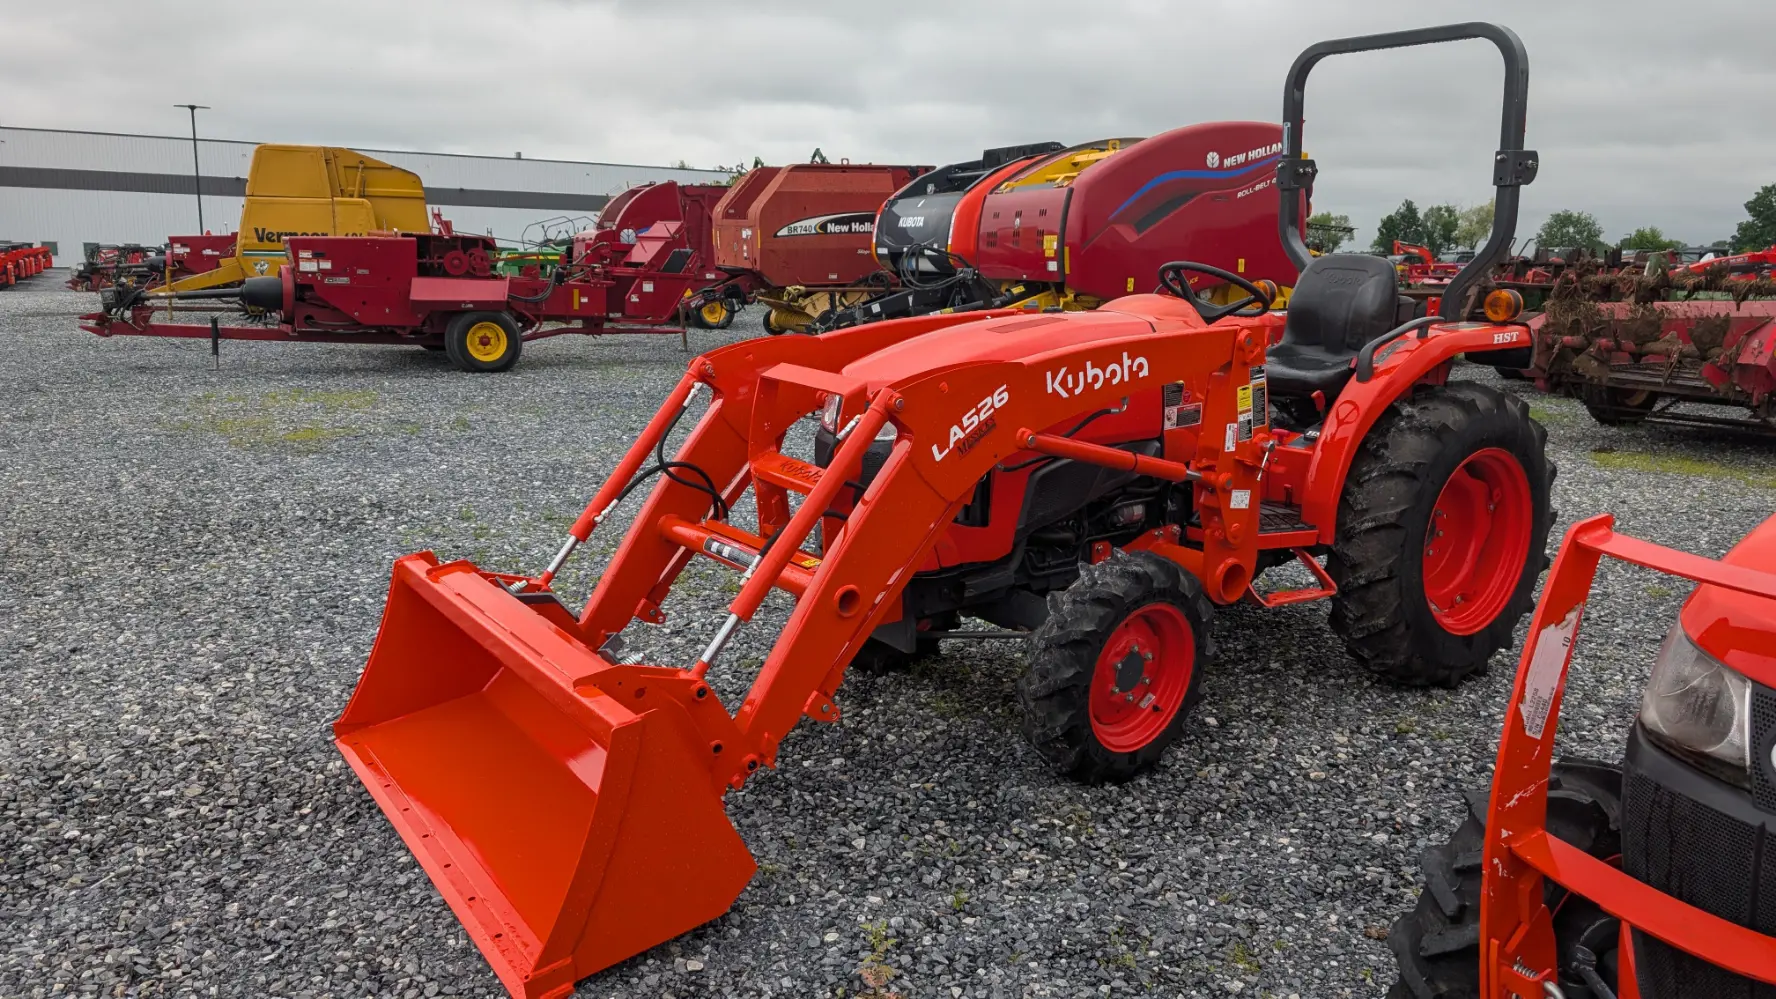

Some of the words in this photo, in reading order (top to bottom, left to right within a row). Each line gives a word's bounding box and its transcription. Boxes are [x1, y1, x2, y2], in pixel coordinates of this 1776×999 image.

[1223, 153, 1246, 168] NEW
[1237, 179, 1270, 199] ROLL-BELT
[787, 225, 813, 234] BR740
[827, 222, 848, 233] New
[898, 216, 925, 228] KUBOTA
[1493, 331, 1519, 344] HST
[1046, 351, 1149, 398] Kubota
[931, 383, 1009, 462] LA526
[1561, 636, 1571, 648] 10
